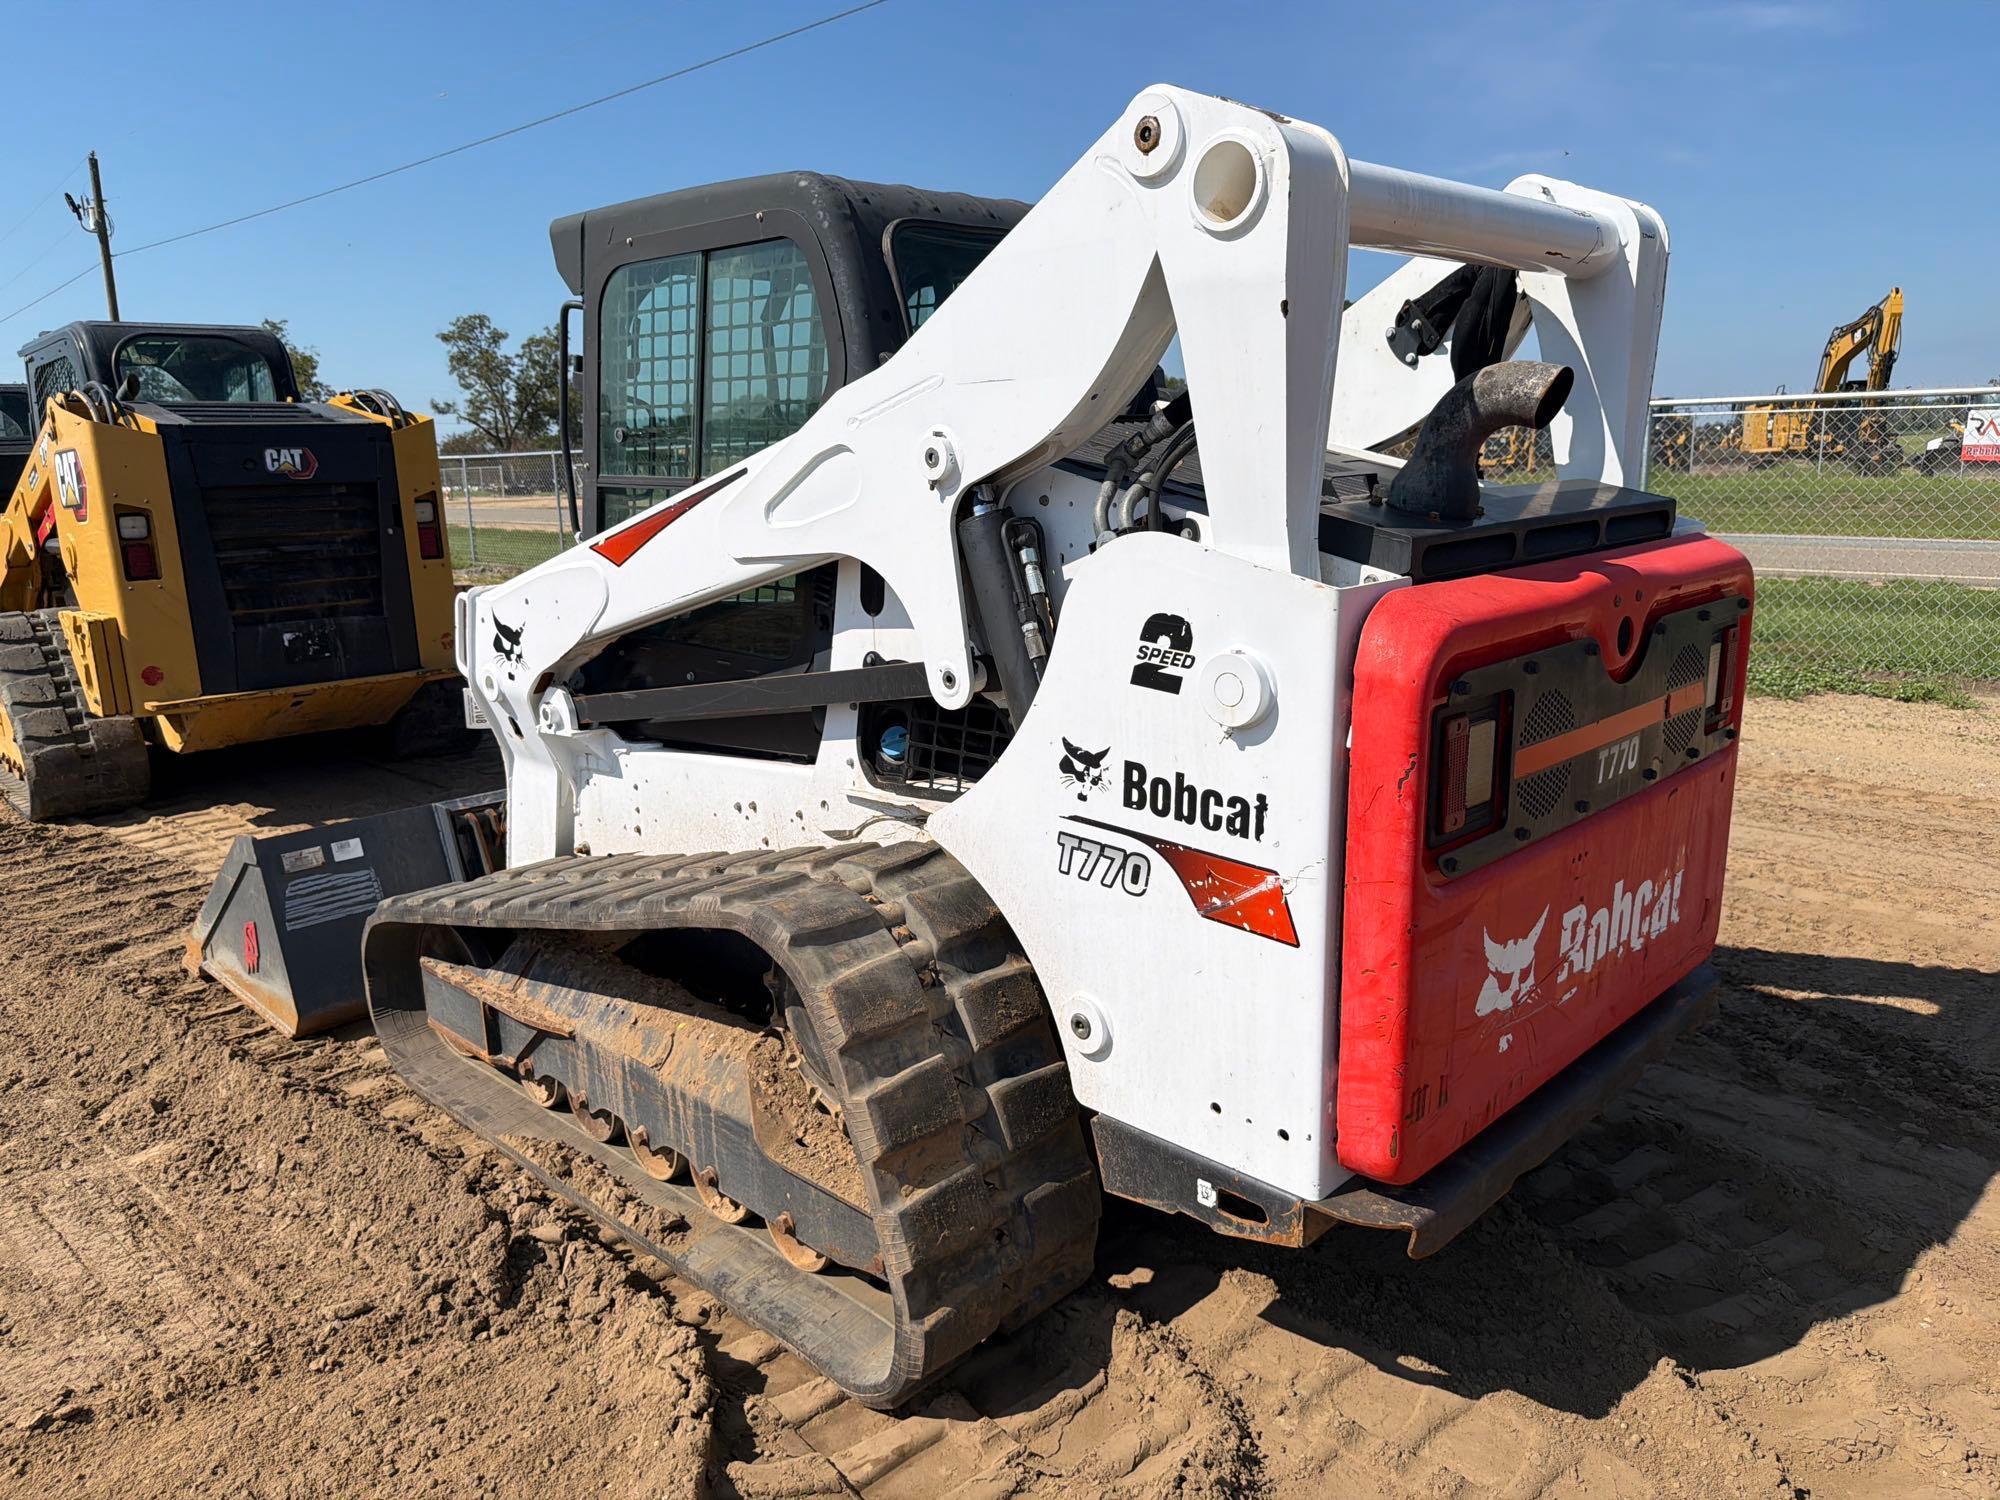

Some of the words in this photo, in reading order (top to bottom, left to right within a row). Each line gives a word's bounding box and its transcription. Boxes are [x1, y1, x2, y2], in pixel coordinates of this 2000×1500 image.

[54, 450, 81, 508] CAT
[265, 448, 303, 472] CAT
[1130, 612, 1193, 695] 2
[1136, 645, 1196, 669] SPEED
[1598, 734, 1641, 785] T770
[1123, 760, 1269, 842] Bobcat
[1057, 831, 1151, 897] T770
